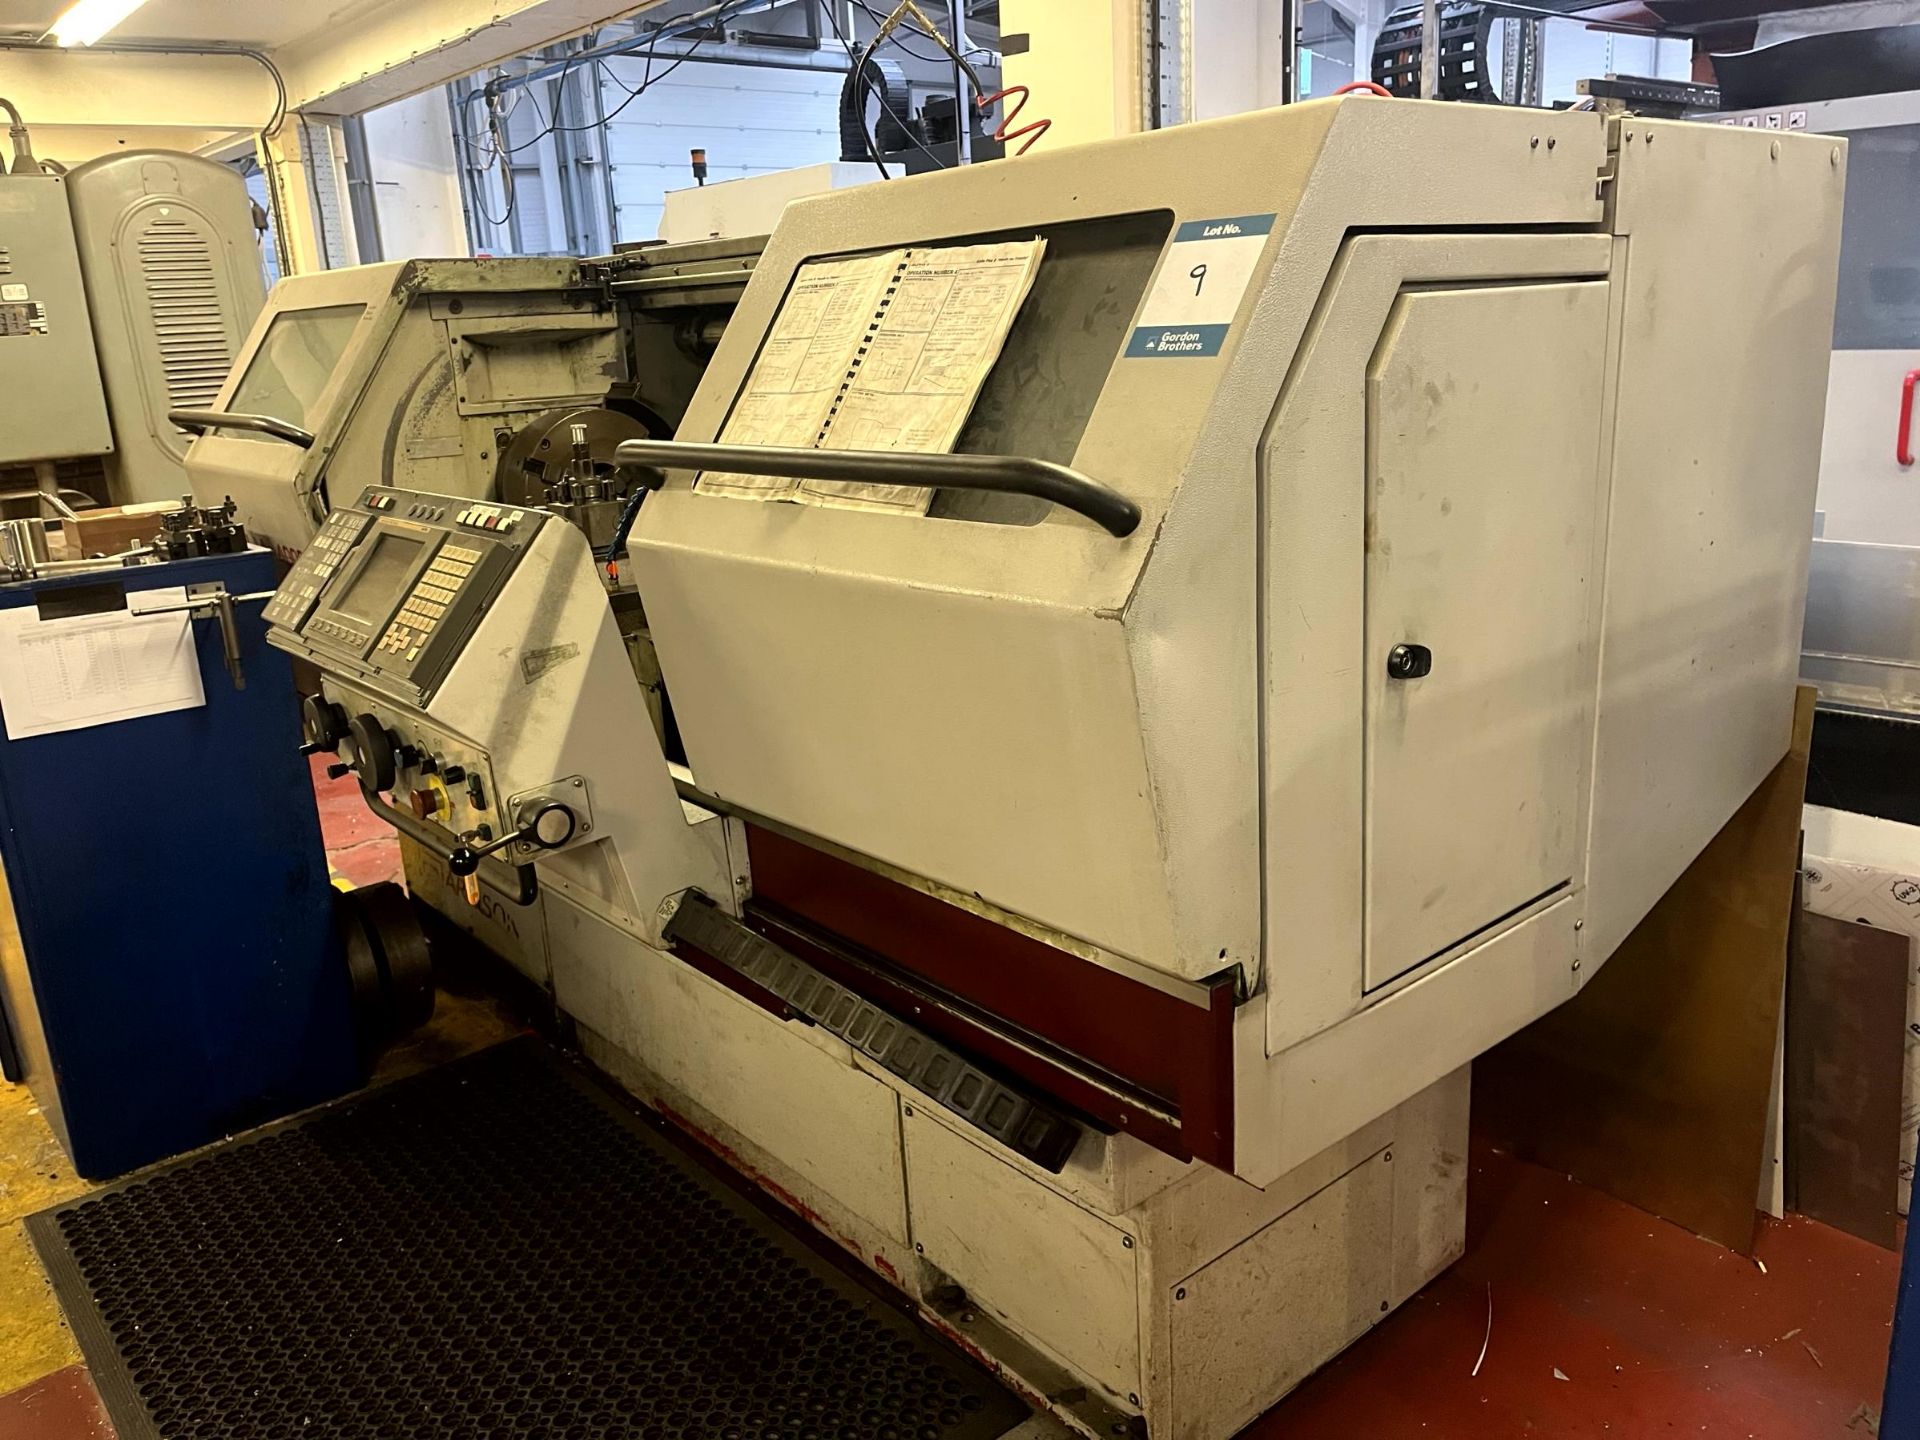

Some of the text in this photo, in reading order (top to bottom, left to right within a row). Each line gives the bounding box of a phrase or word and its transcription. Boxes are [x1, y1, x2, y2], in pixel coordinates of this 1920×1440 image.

[1203, 224, 1242, 236] Lot No.
[1190, 264, 1207, 296] 9
[1162, 332, 1200, 342] Gordon
[1158, 341, 1202, 351] Brothers
